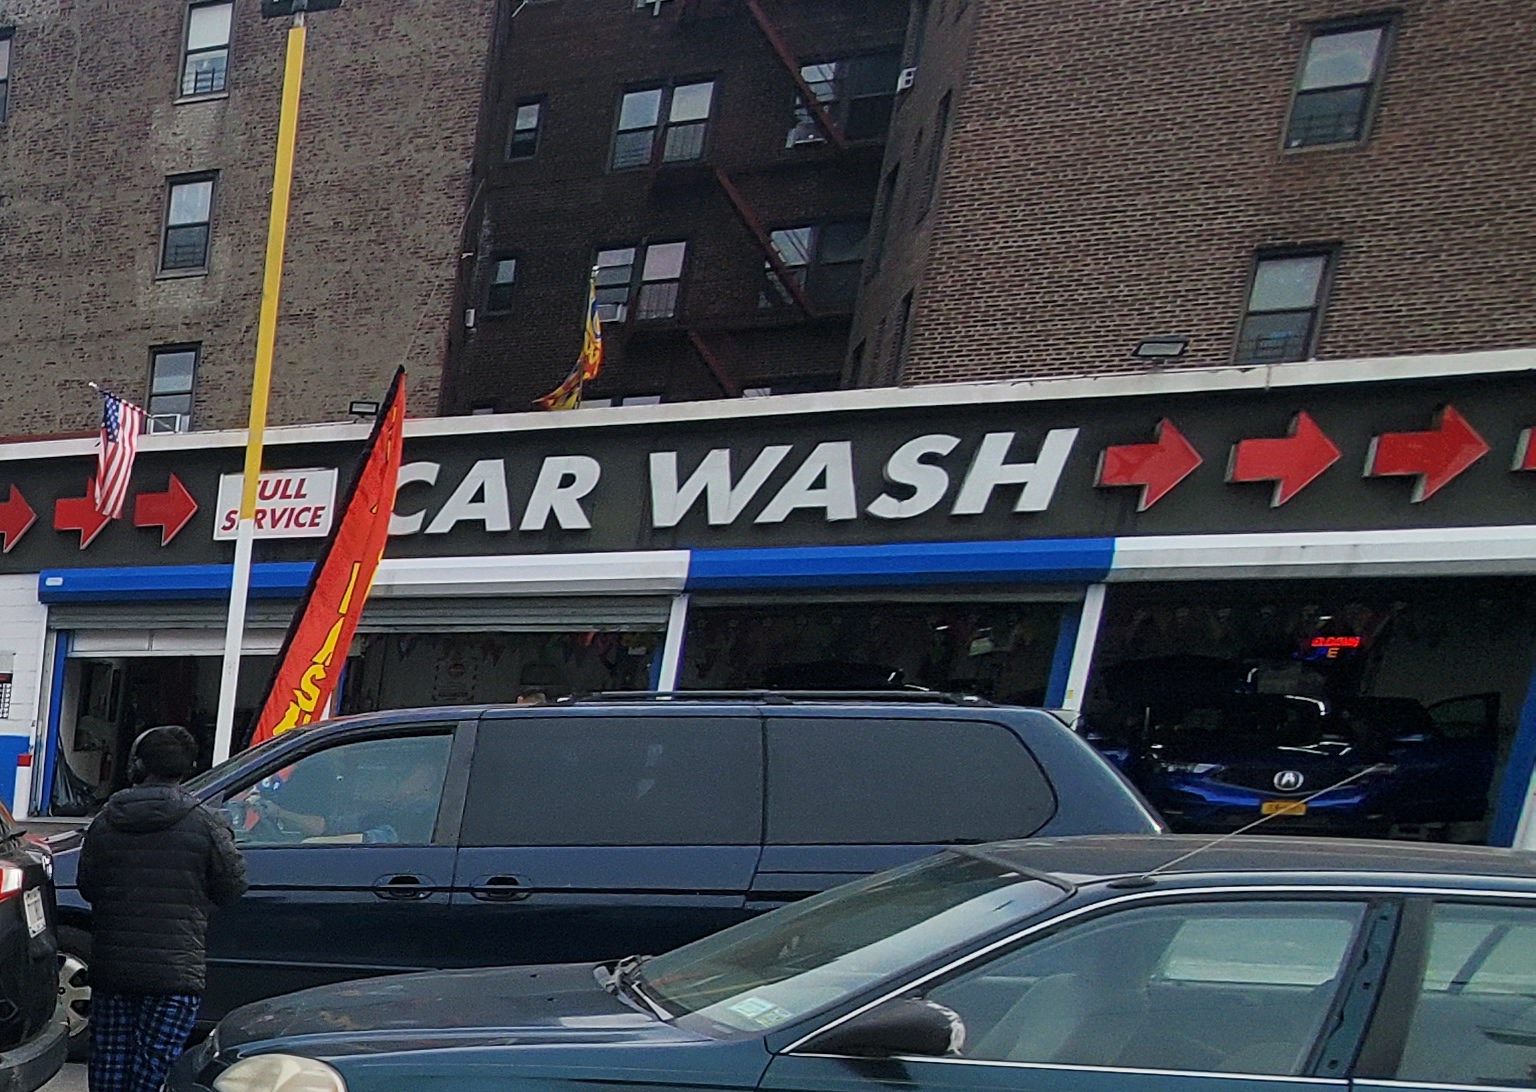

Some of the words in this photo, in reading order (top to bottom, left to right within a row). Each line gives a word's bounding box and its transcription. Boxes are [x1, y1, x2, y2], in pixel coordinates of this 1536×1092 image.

[258, 477, 307, 501] ULL
[387, 455, 602, 536] CAR
[648, 427, 1080, 529] WASH
[220, 505, 326, 531] SRVICE
